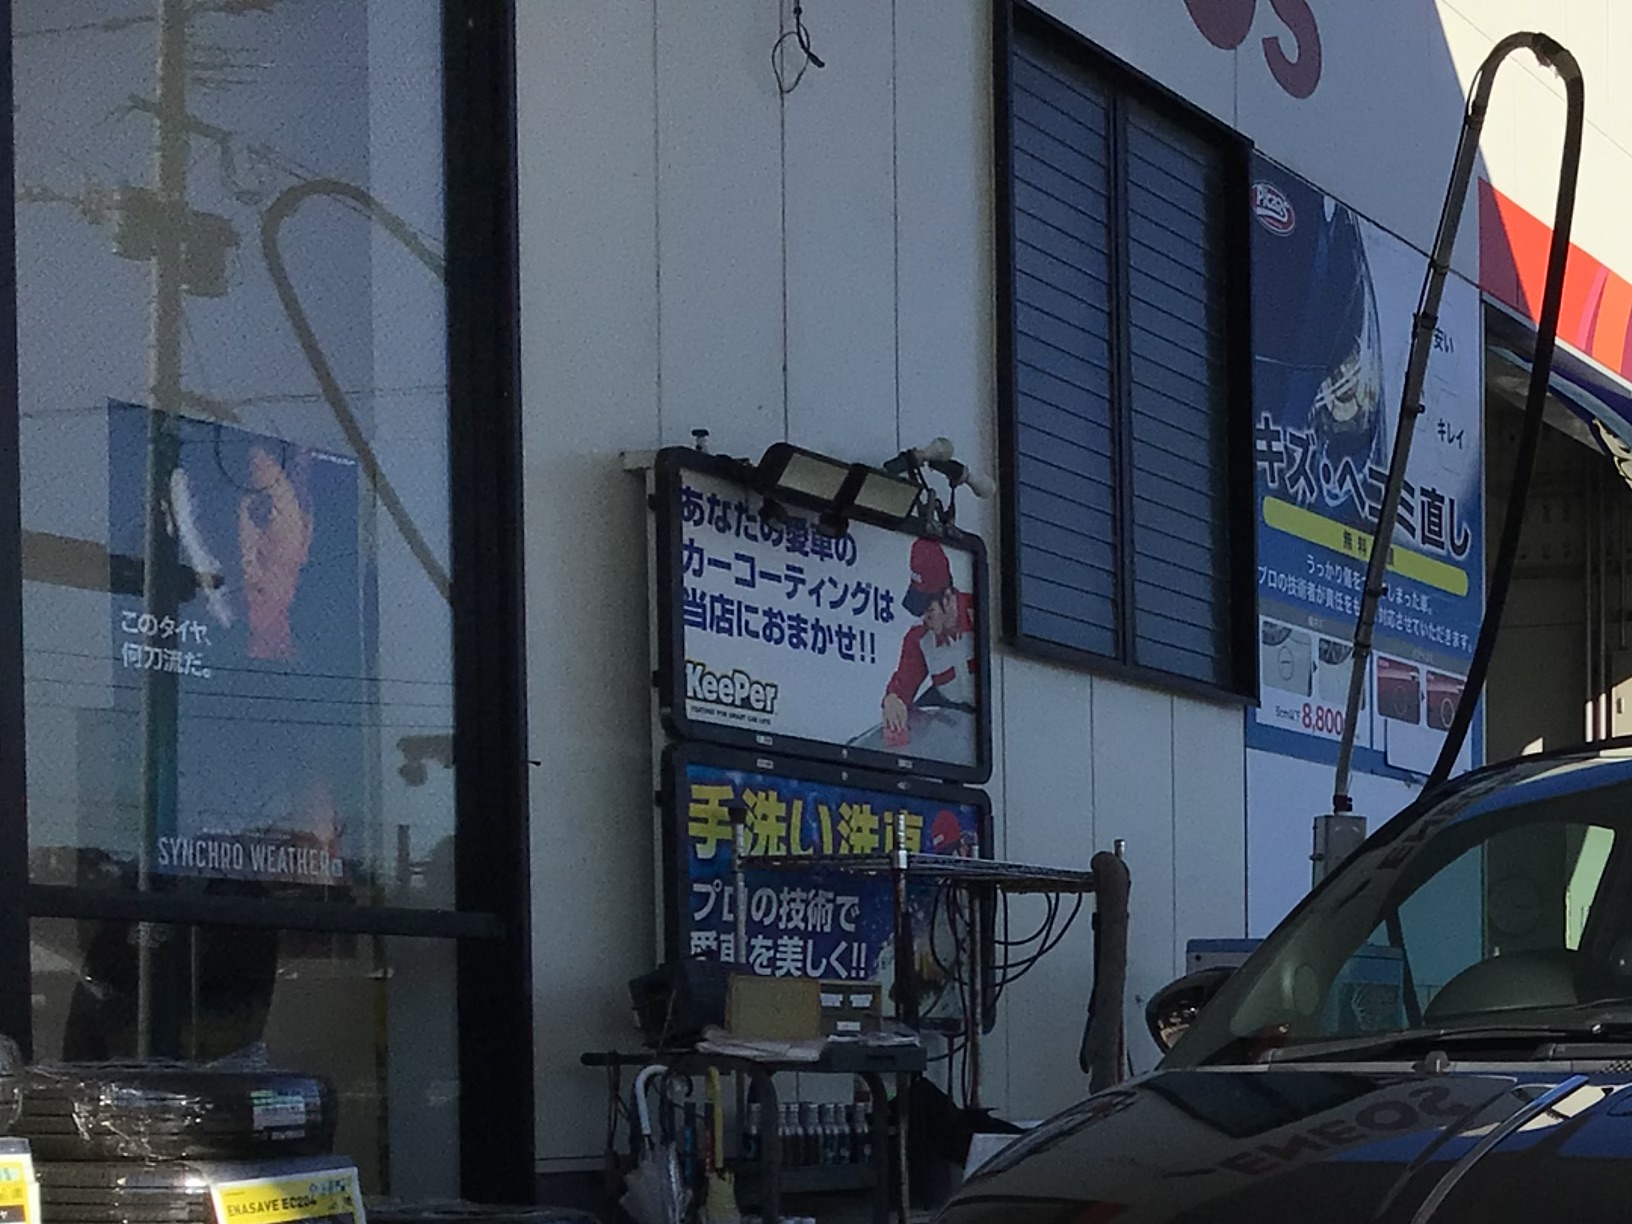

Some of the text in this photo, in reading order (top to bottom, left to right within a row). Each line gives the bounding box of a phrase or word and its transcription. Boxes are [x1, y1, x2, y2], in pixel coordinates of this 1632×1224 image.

[1437, 419, 1465, 449] キレイ
[1255, 412, 1471, 561] キズ・ヘコミ直し
[681, 537, 895, 625] カーコーティングは
[682, 587, 877, 665] 当店におまかせ!!
[685, 660, 778, 714] KeePer
[1302, 703, 1345, 735] 8,800
[157, 836, 330, 878] SYNCHRO WEATHER
